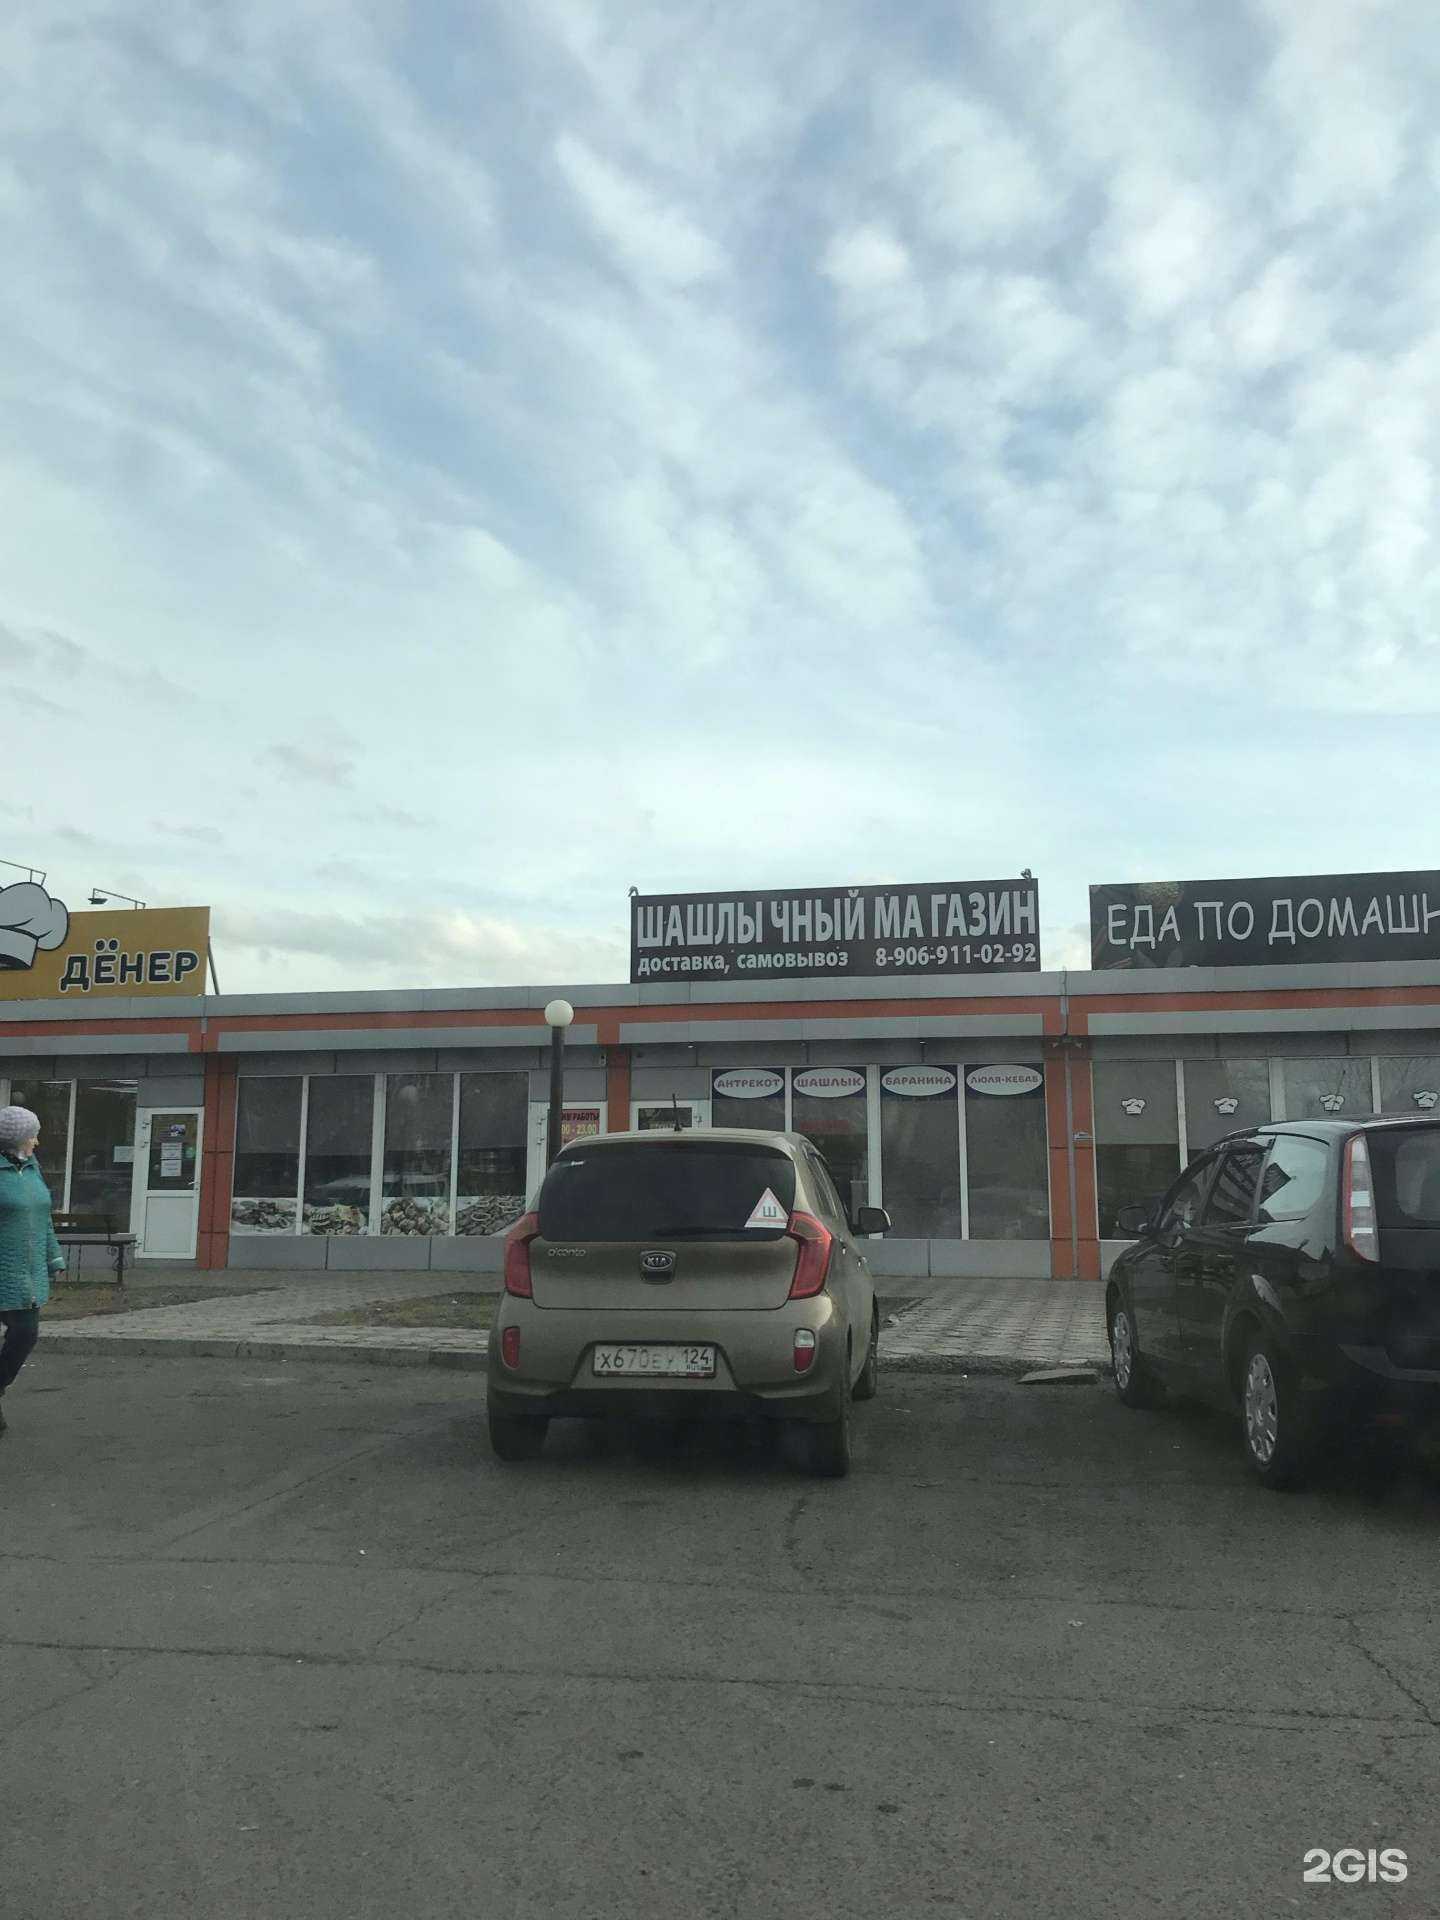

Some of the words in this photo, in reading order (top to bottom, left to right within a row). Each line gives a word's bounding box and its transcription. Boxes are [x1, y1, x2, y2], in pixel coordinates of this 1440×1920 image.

[1107, 904, 1181, 950] ЕДА
[1194, 901, 1255, 941] ПО
[637, 954, 730, 976] доставка,
[737, 951, 849, 969] самовывоз
[875, 942, 1037, 967] 8-906-911-02-92
[59, 938, 199, 992] ДЁНЕР
[717, 1078, 780, 1088] АНТРЕКОТ
[797, 1077, 861, 1087] ШАШЛЫК
[885, 1075, 952, 1086] БАРАНИНА
[647, 1257, 667, 1267] KIA
